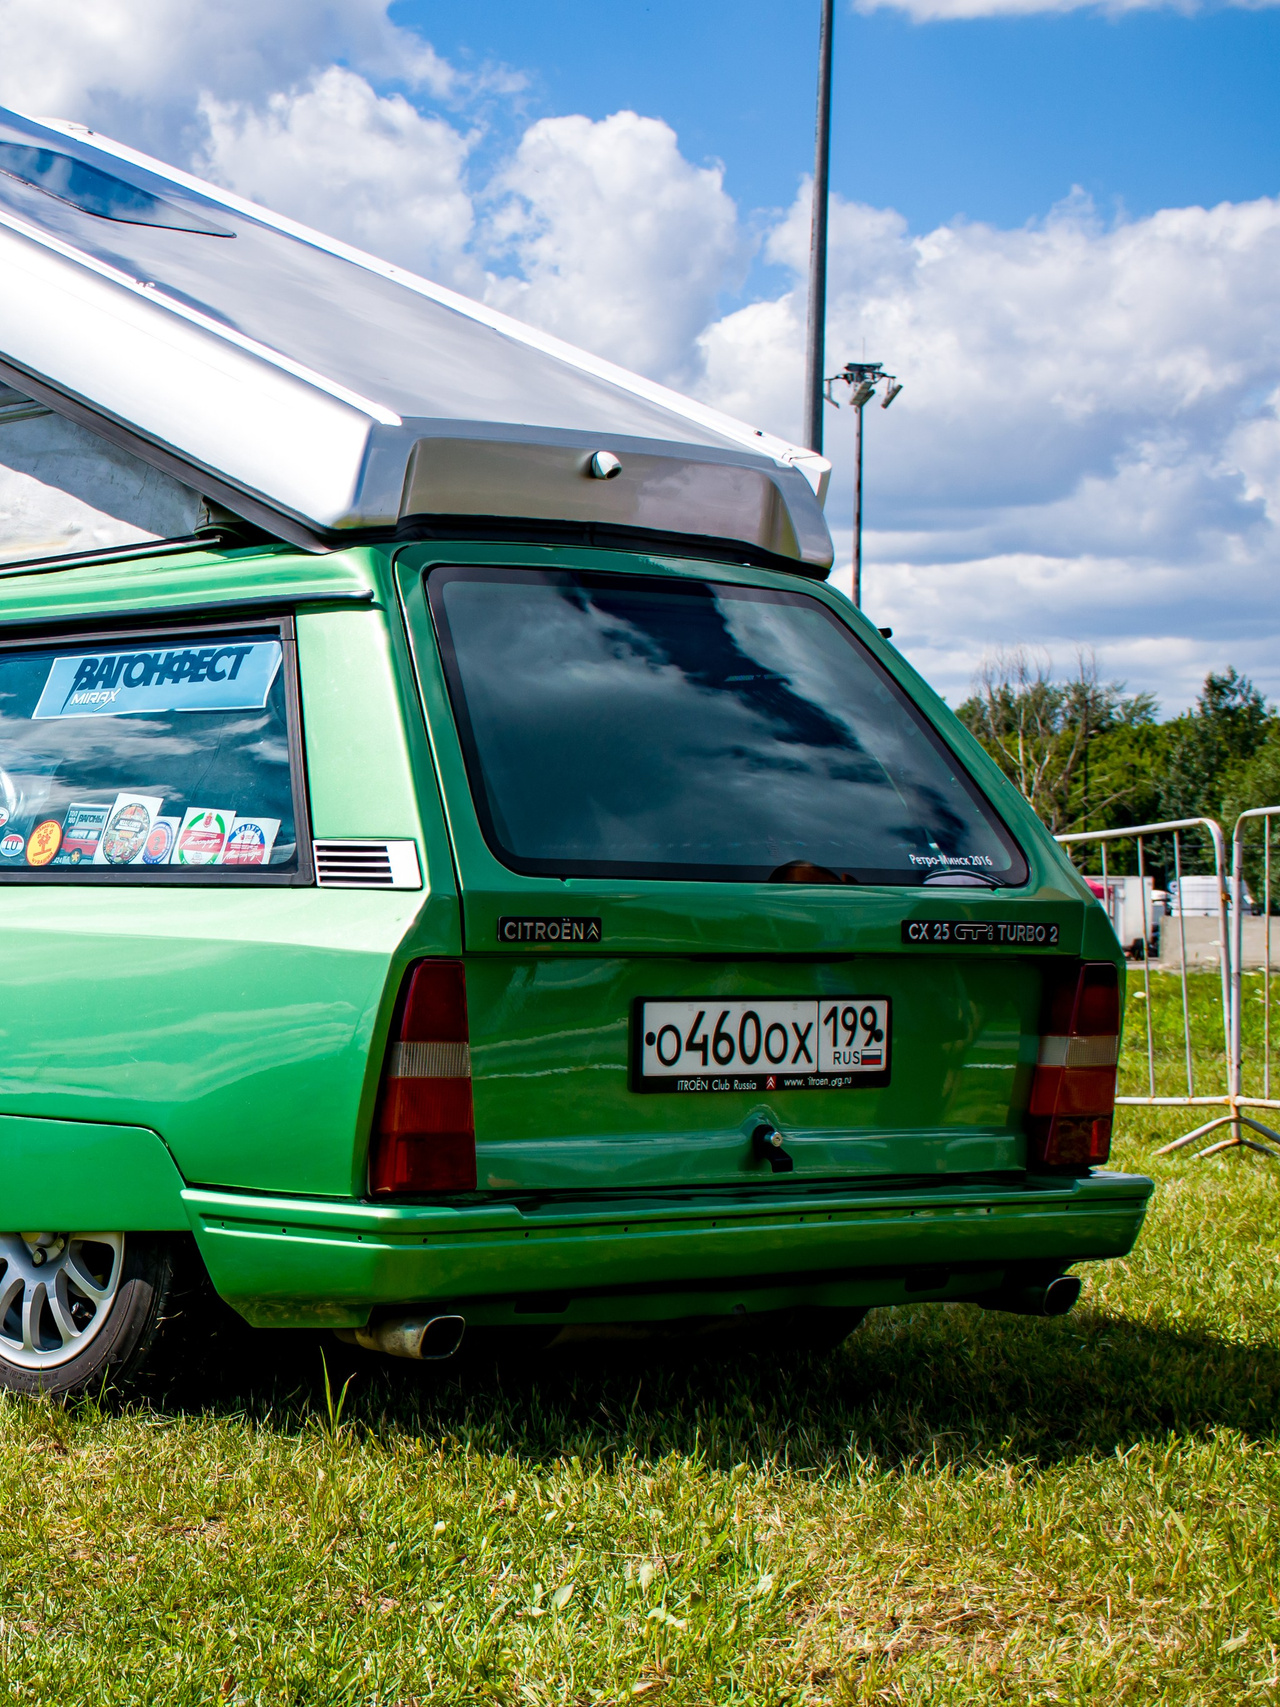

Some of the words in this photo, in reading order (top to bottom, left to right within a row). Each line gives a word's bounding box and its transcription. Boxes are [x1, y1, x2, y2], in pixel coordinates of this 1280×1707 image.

[60, 646, 254, 712] ВАГОНФЕСТ
[70, 688, 121, 713] MIRAX
[4, 840, 19, 850] LU
[909, 854, 970, 867] Ретро-Минск
[970, 855, 993, 866] 2016
[504, 918, 584, 940] CITROËN
[908, 923, 929, 940] CX
[933, 923, 950, 940] 25
[997, 924, 1046, 942] TURBO
[1050, 925, 1058, 943] 2
[823, 1005, 879, 1048] 199
[833, 1051, 860, 1066] RUS
[712, 1078, 730, 1091] Club
[733, 1078, 757, 1091] Russia
